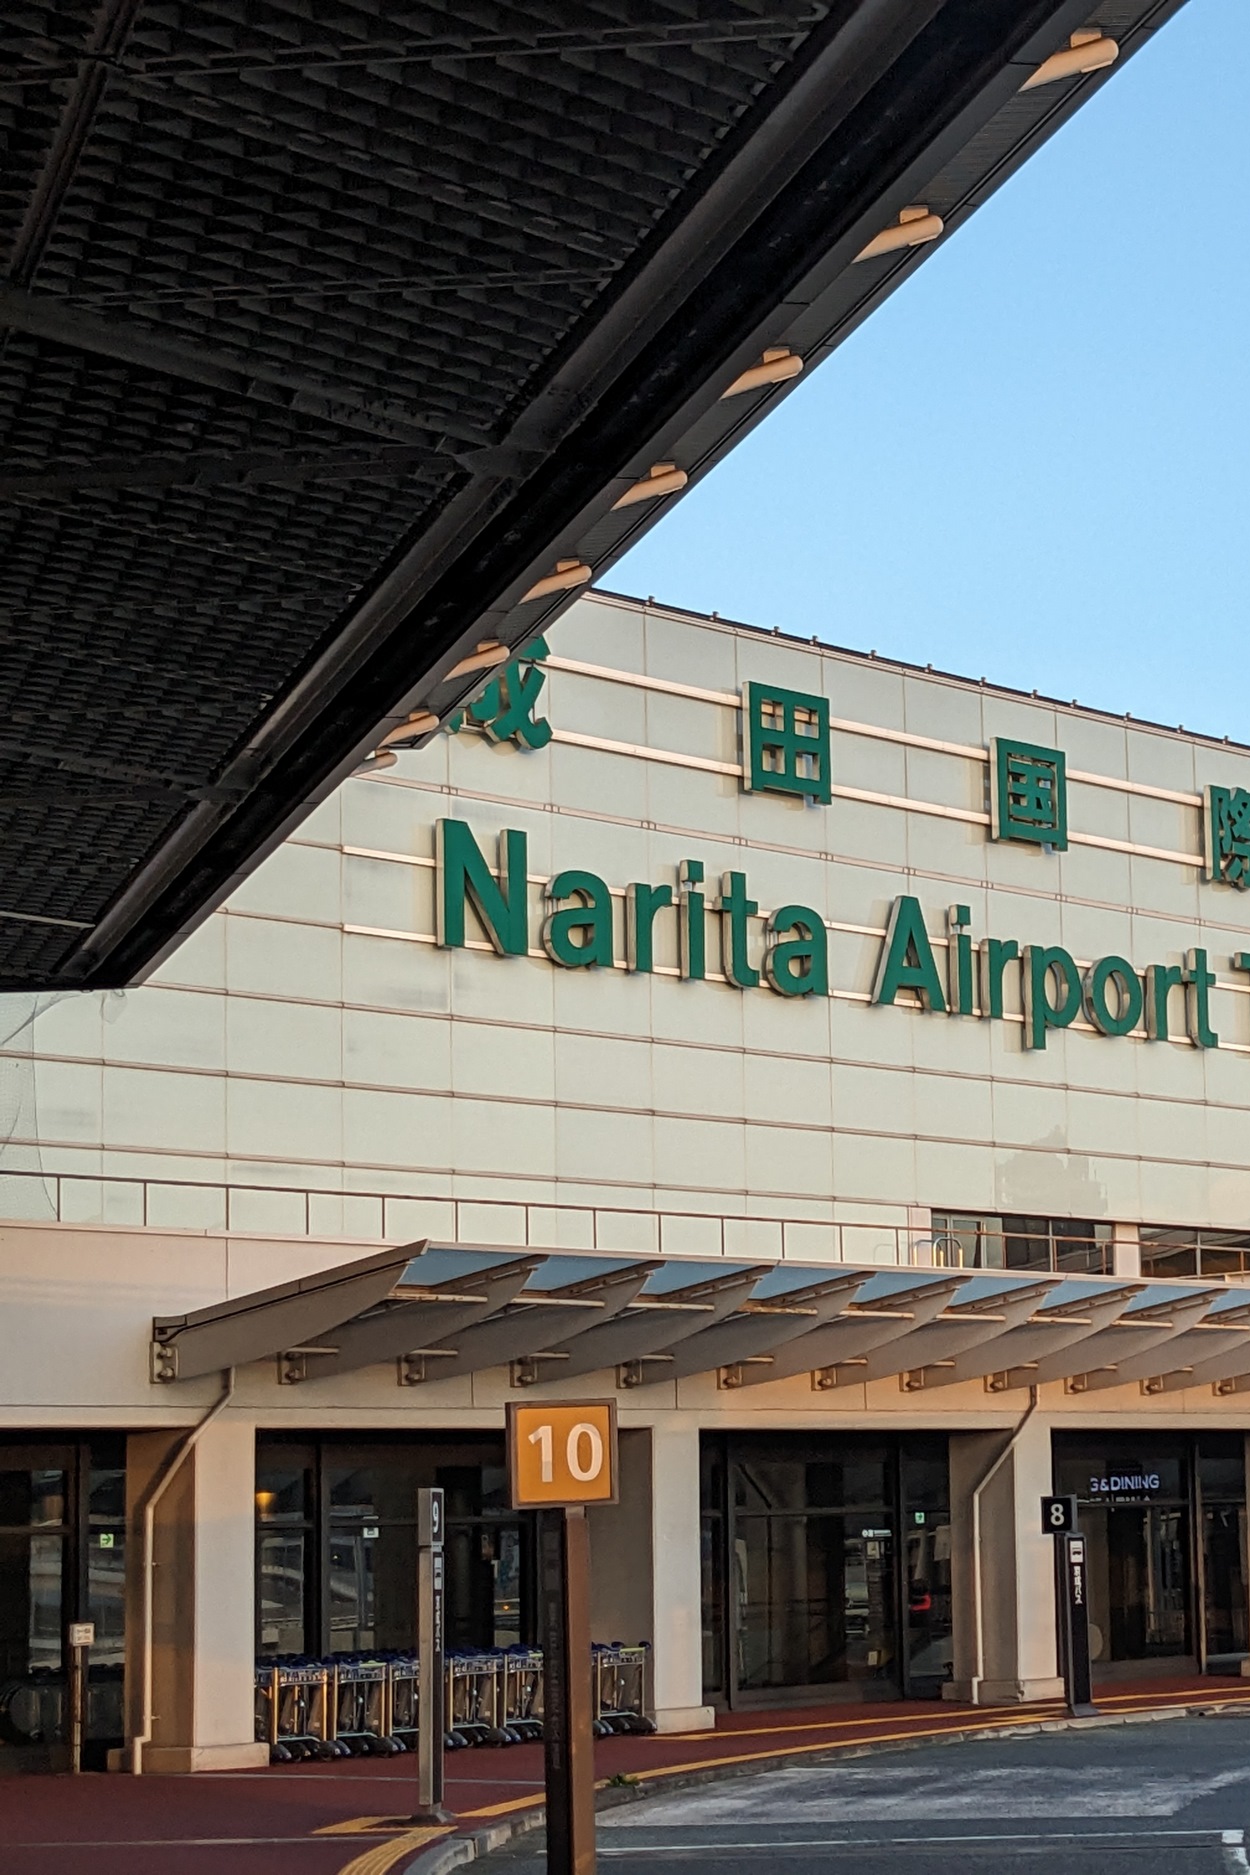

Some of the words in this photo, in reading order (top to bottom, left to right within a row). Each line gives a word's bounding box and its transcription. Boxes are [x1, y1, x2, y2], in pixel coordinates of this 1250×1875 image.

[435, 817, 829, 997] Narita
[872, 895, 1219, 1050] Airport
[527, 1422, 603, 1483] 10
[432, 1500, 440, 1533] 9
[1050, 1503, 1065, 1526] 8
